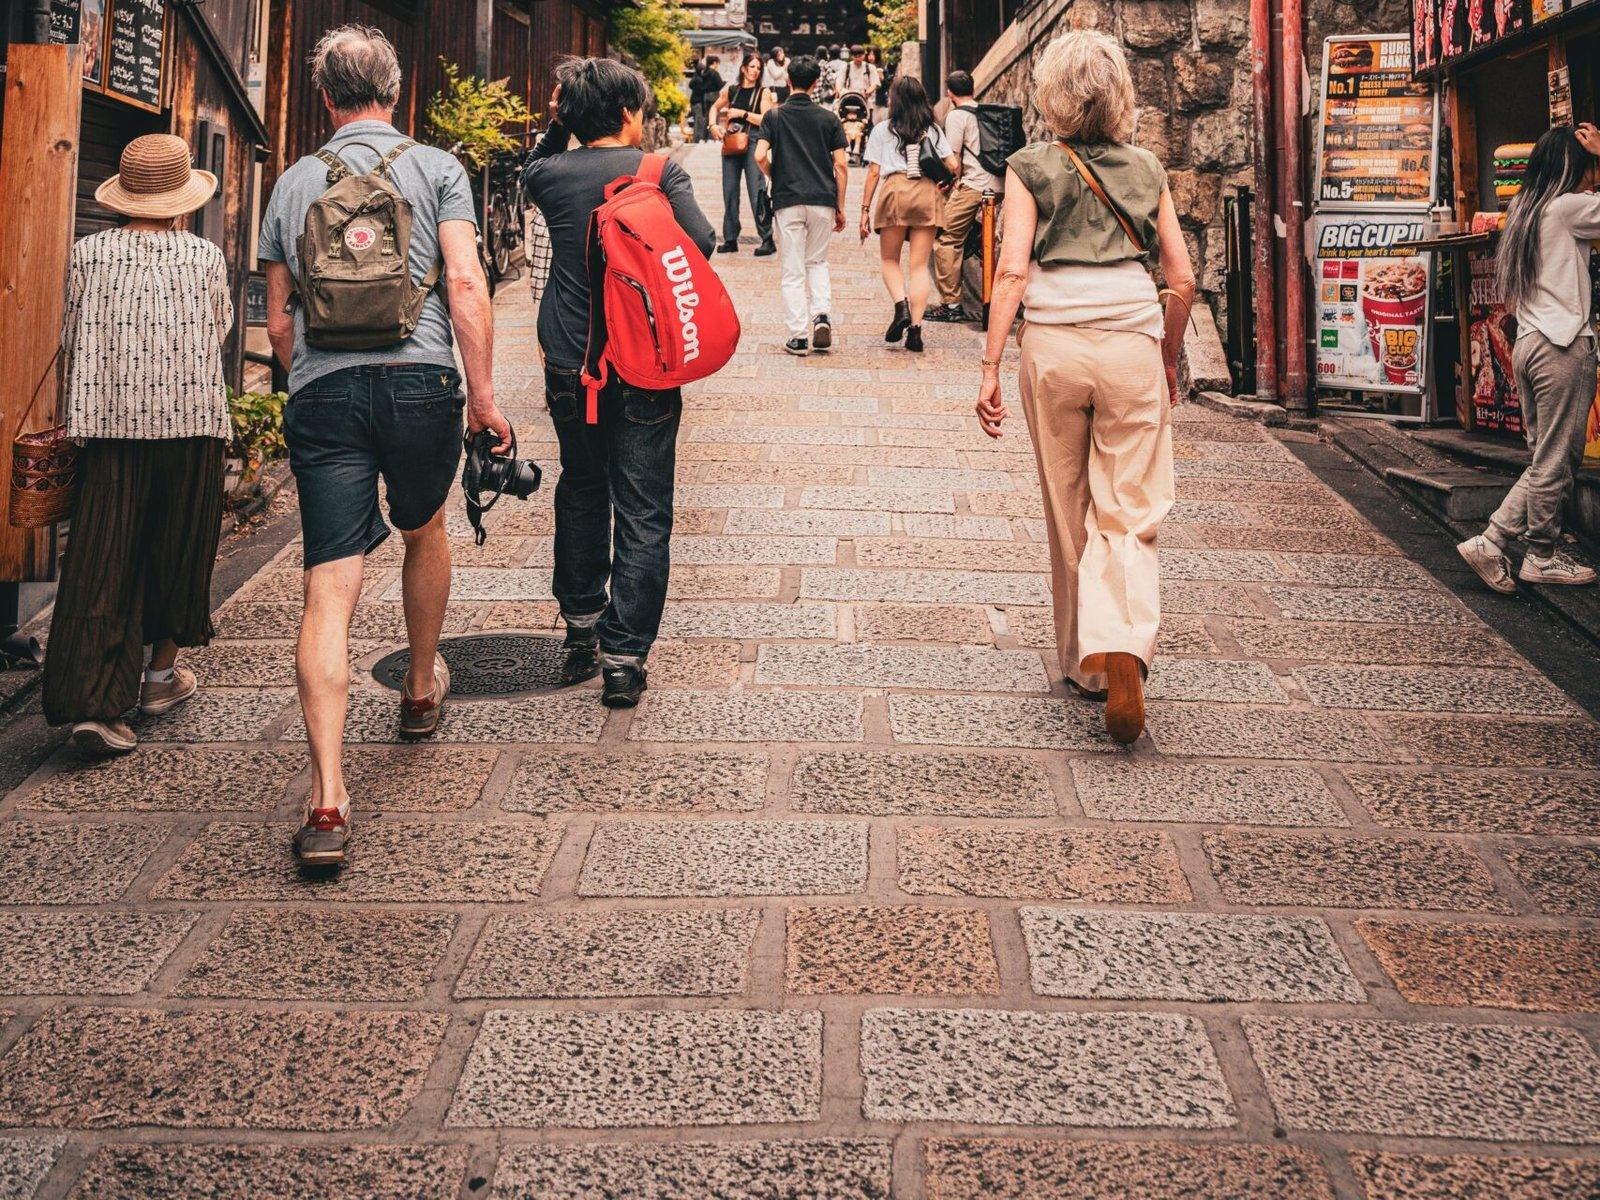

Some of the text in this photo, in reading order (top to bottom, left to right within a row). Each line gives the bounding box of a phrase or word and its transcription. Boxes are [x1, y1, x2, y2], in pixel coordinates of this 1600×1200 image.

[1328, 77, 1355, 95] No.1
[1322, 181, 1351, 199] No.5
[1319, 248, 1338, 257] Drink
[1339, 248, 1346, 257] to
[1347, 248, 1364, 259] your
[1364, 247, 1388, 257] heart's
[661, 245, 700, 365] Wilson
[1384, 329, 1418, 346] BIG
[1387, 345, 1413, 356] CUP
